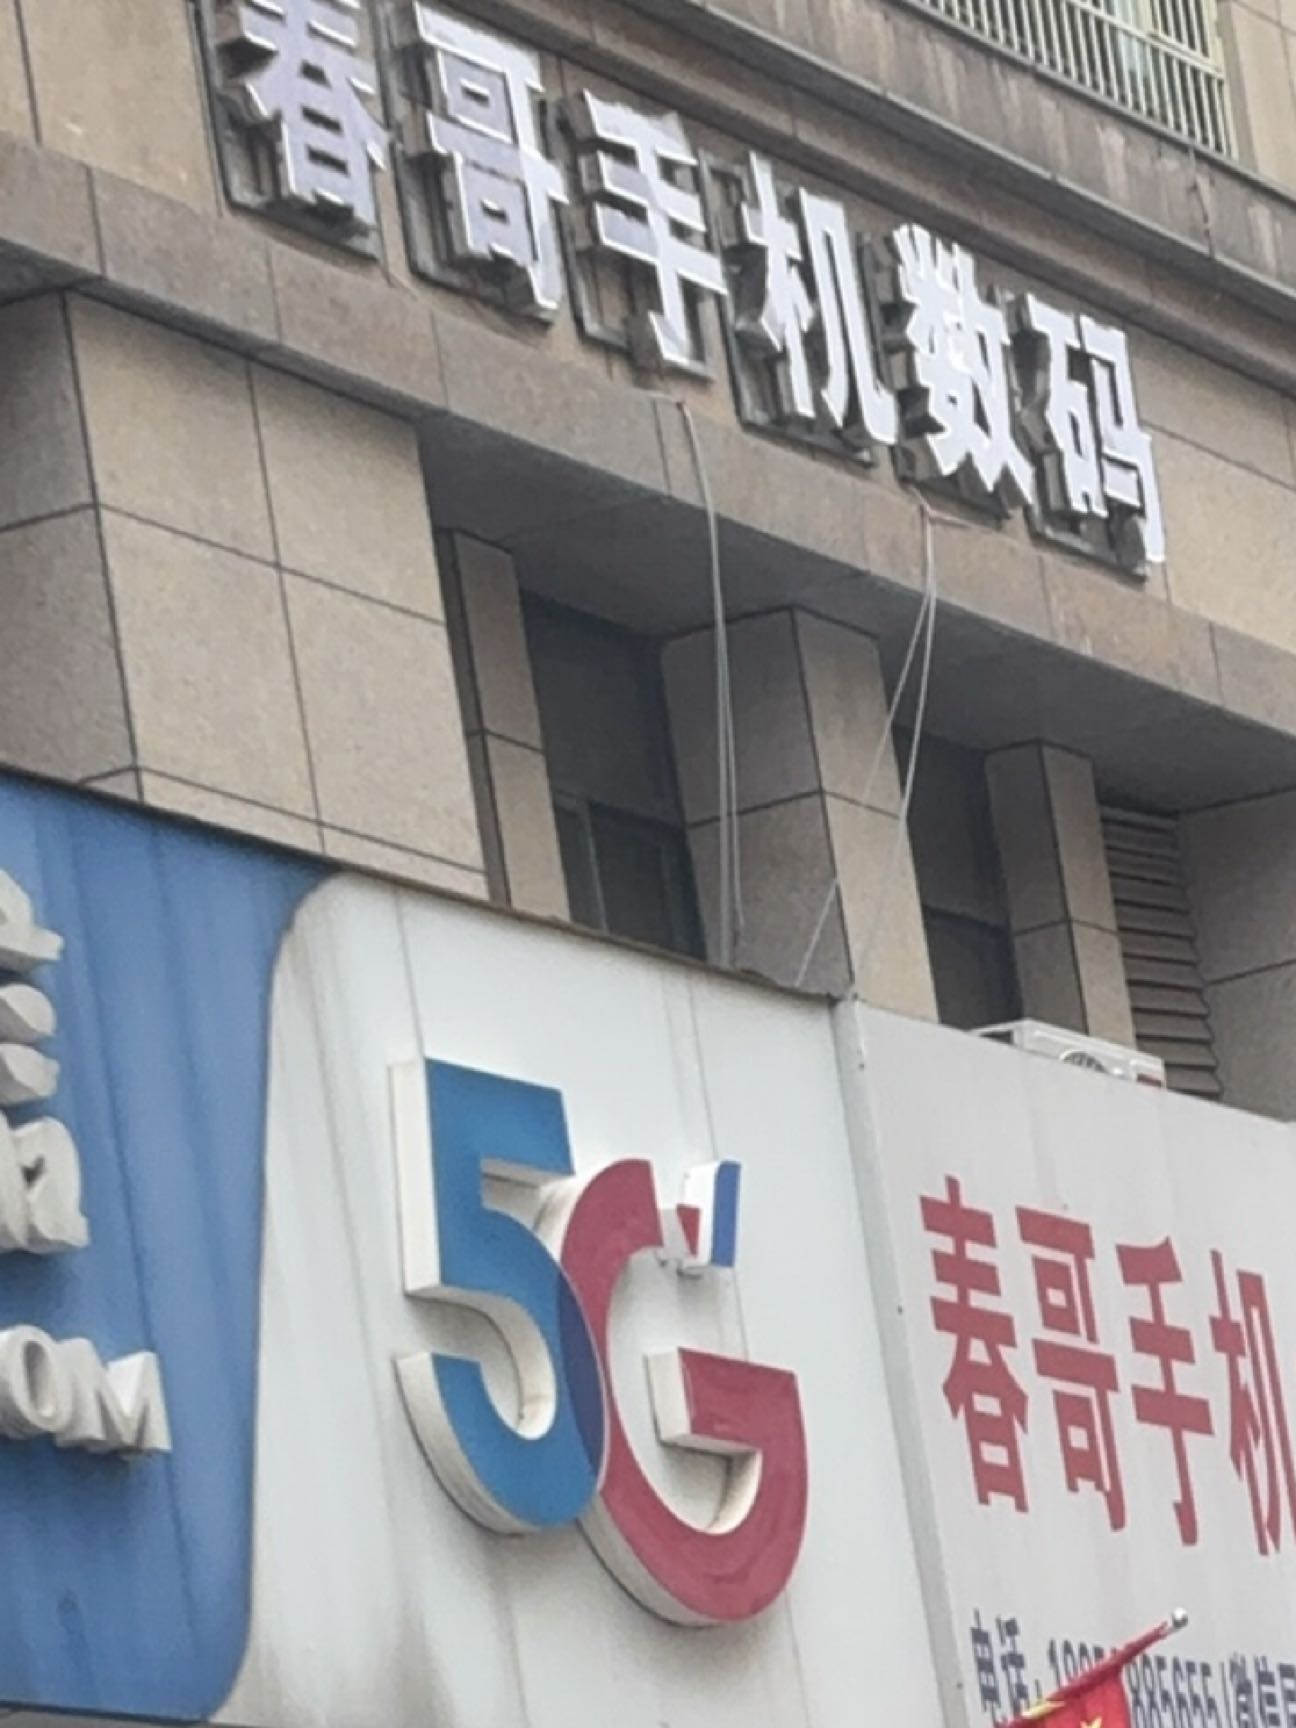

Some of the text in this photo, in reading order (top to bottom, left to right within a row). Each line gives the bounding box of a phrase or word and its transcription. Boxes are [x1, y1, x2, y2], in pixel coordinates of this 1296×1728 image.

[218, 0, 1168, 565] 春哥手机数码
[388, 1056, 810, 1629] 5G
